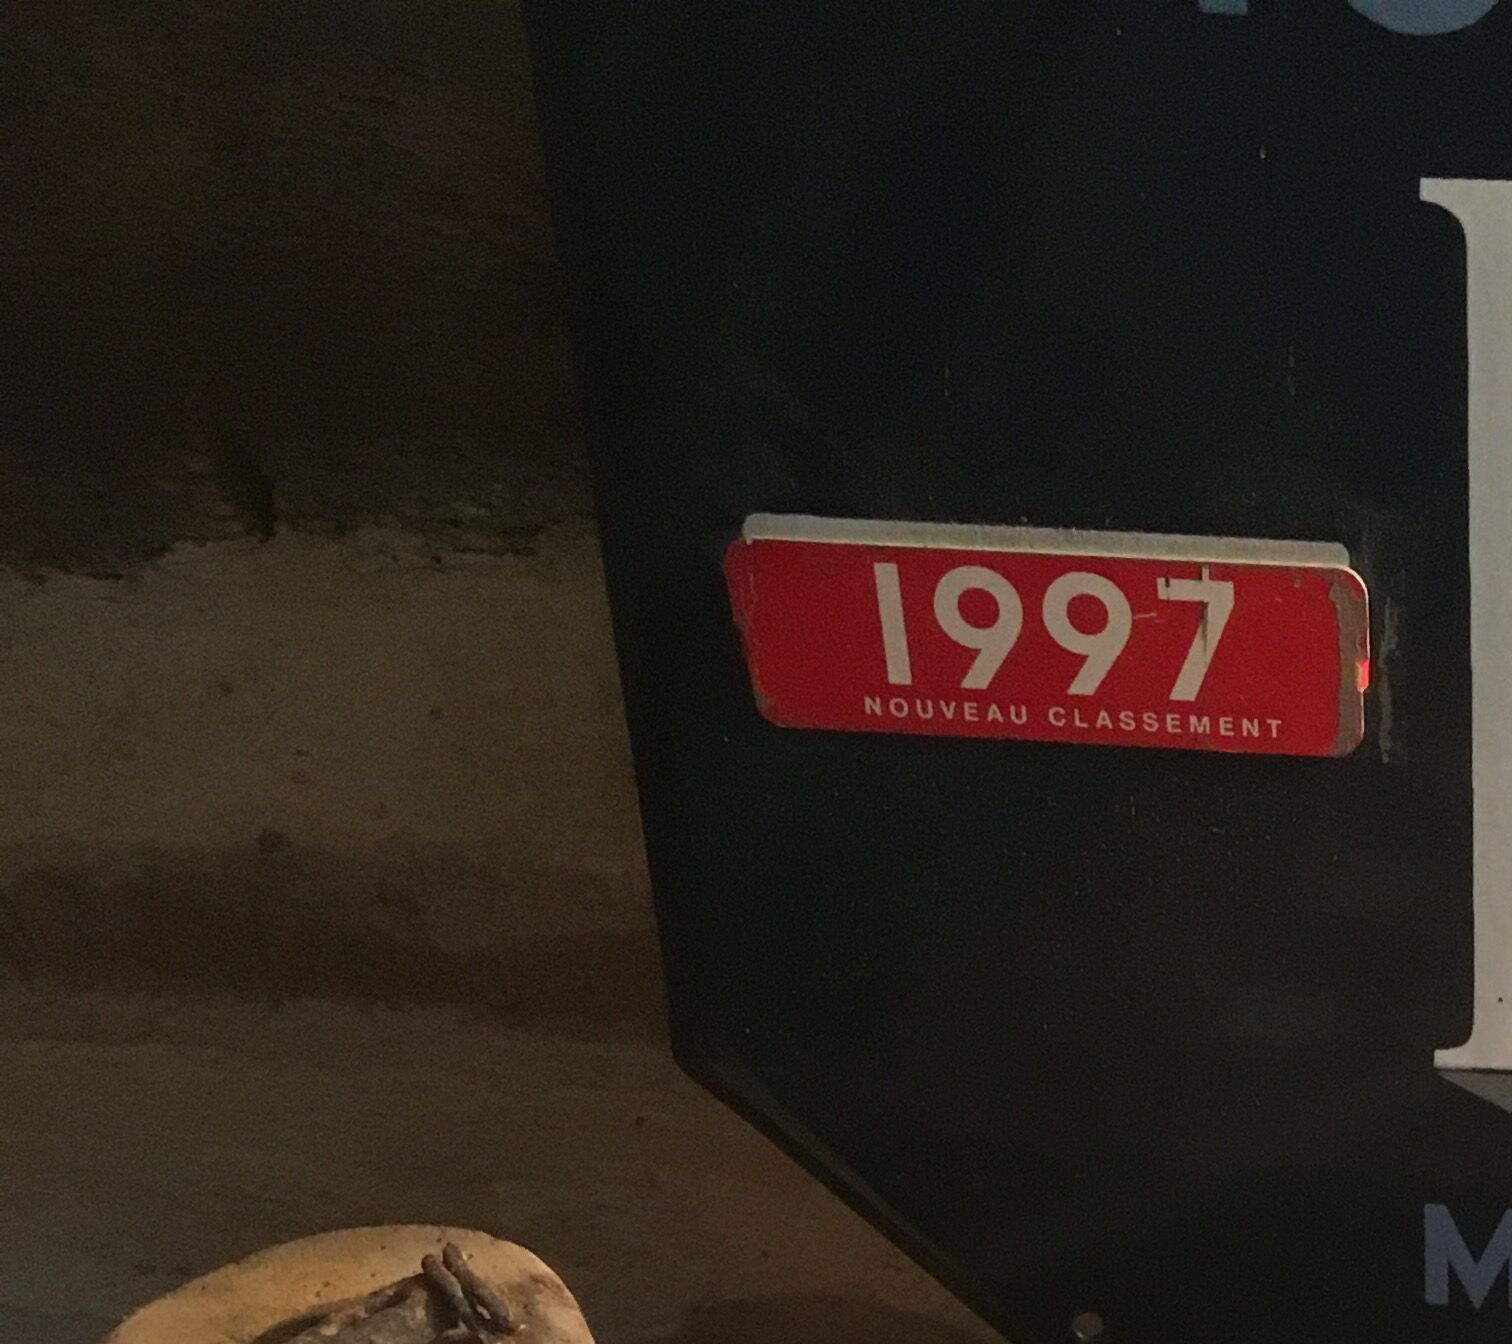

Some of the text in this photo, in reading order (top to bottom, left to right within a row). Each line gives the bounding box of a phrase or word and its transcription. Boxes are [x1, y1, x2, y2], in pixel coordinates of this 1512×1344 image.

[873, 562, 1235, 701] 1997
[864, 696, 1282, 739] NOUVEAU CLASSEMENT
